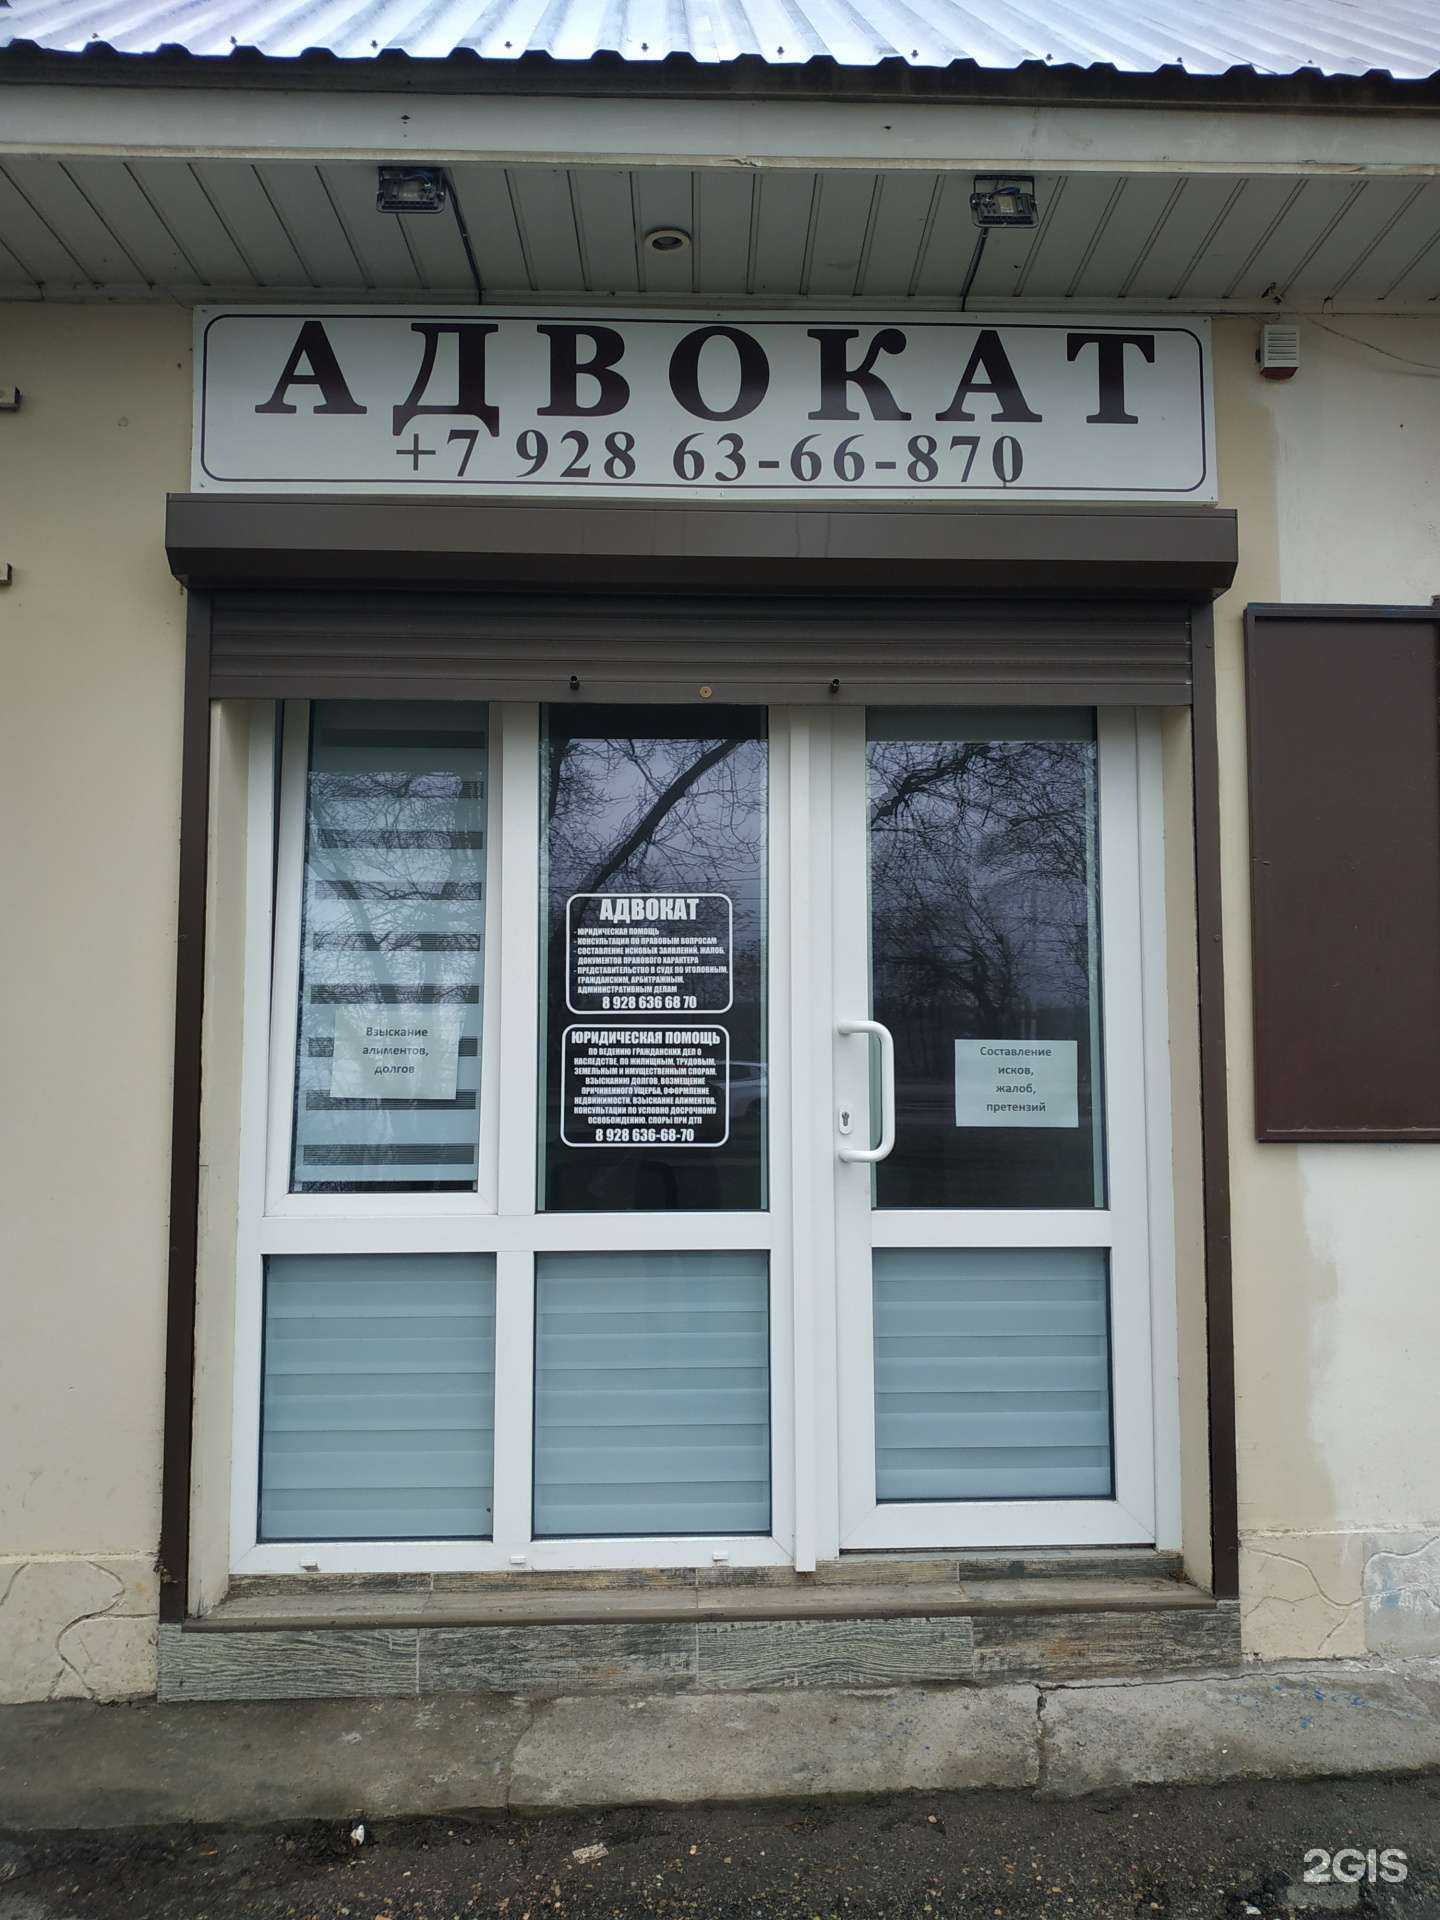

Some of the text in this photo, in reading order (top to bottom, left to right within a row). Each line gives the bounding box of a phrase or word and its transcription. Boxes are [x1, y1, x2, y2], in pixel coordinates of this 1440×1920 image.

[255, 320, 1154, 437] АДВОКАТ
[395, 429, 1024, 485] +7 928 63-66-870
[600, 899, 699, 923] АДВОКАТ
[578, 928, 627, 936] ЮРИДИЧЕСКАЯ
[578, 957, 622, 965] ДОКУМЕНТОВ
[578, 986, 677, 994] АДМИНИСТРАТИВНЫМ ДЕЛАМ
[602, 996, 697, 1008] 8 928 636 68 70
[366, 1027, 428, 1036] Взыскание
[571, 1031, 720, 1046] ЮРИДИЧЕСКАЯ ПОМОЩЬ
[363, 1047, 429, 1056] алиментов,
[599, 1048, 631, 1056] ВЕДЕНИЮ
[633, 1048, 681, 1056] ГРАЖДАНСКИХ
[682, 1048, 696, 1056] ДЕЛ
[980, 1047, 1052, 1056] Составление
[375, 1066, 414, 1075] долгов
[625, 1068, 686, 1076] ИМУЩЕСТВЕННЫМ
[998, 1067, 1034, 1076] исков,
[660, 1077, 706, 1085] ВОЗМЕЩЕНИЕ
[996, 1084, 1036, 1094] жалоб,
[670, 1107, 716, 1115] ДОСРОЧНОМУ
[987, 1102, 1046, 1113] претензий
[689, 1117, 702, 1125] ДТП
[596, 1129, 694, 1141] 8 928 636-68-70
